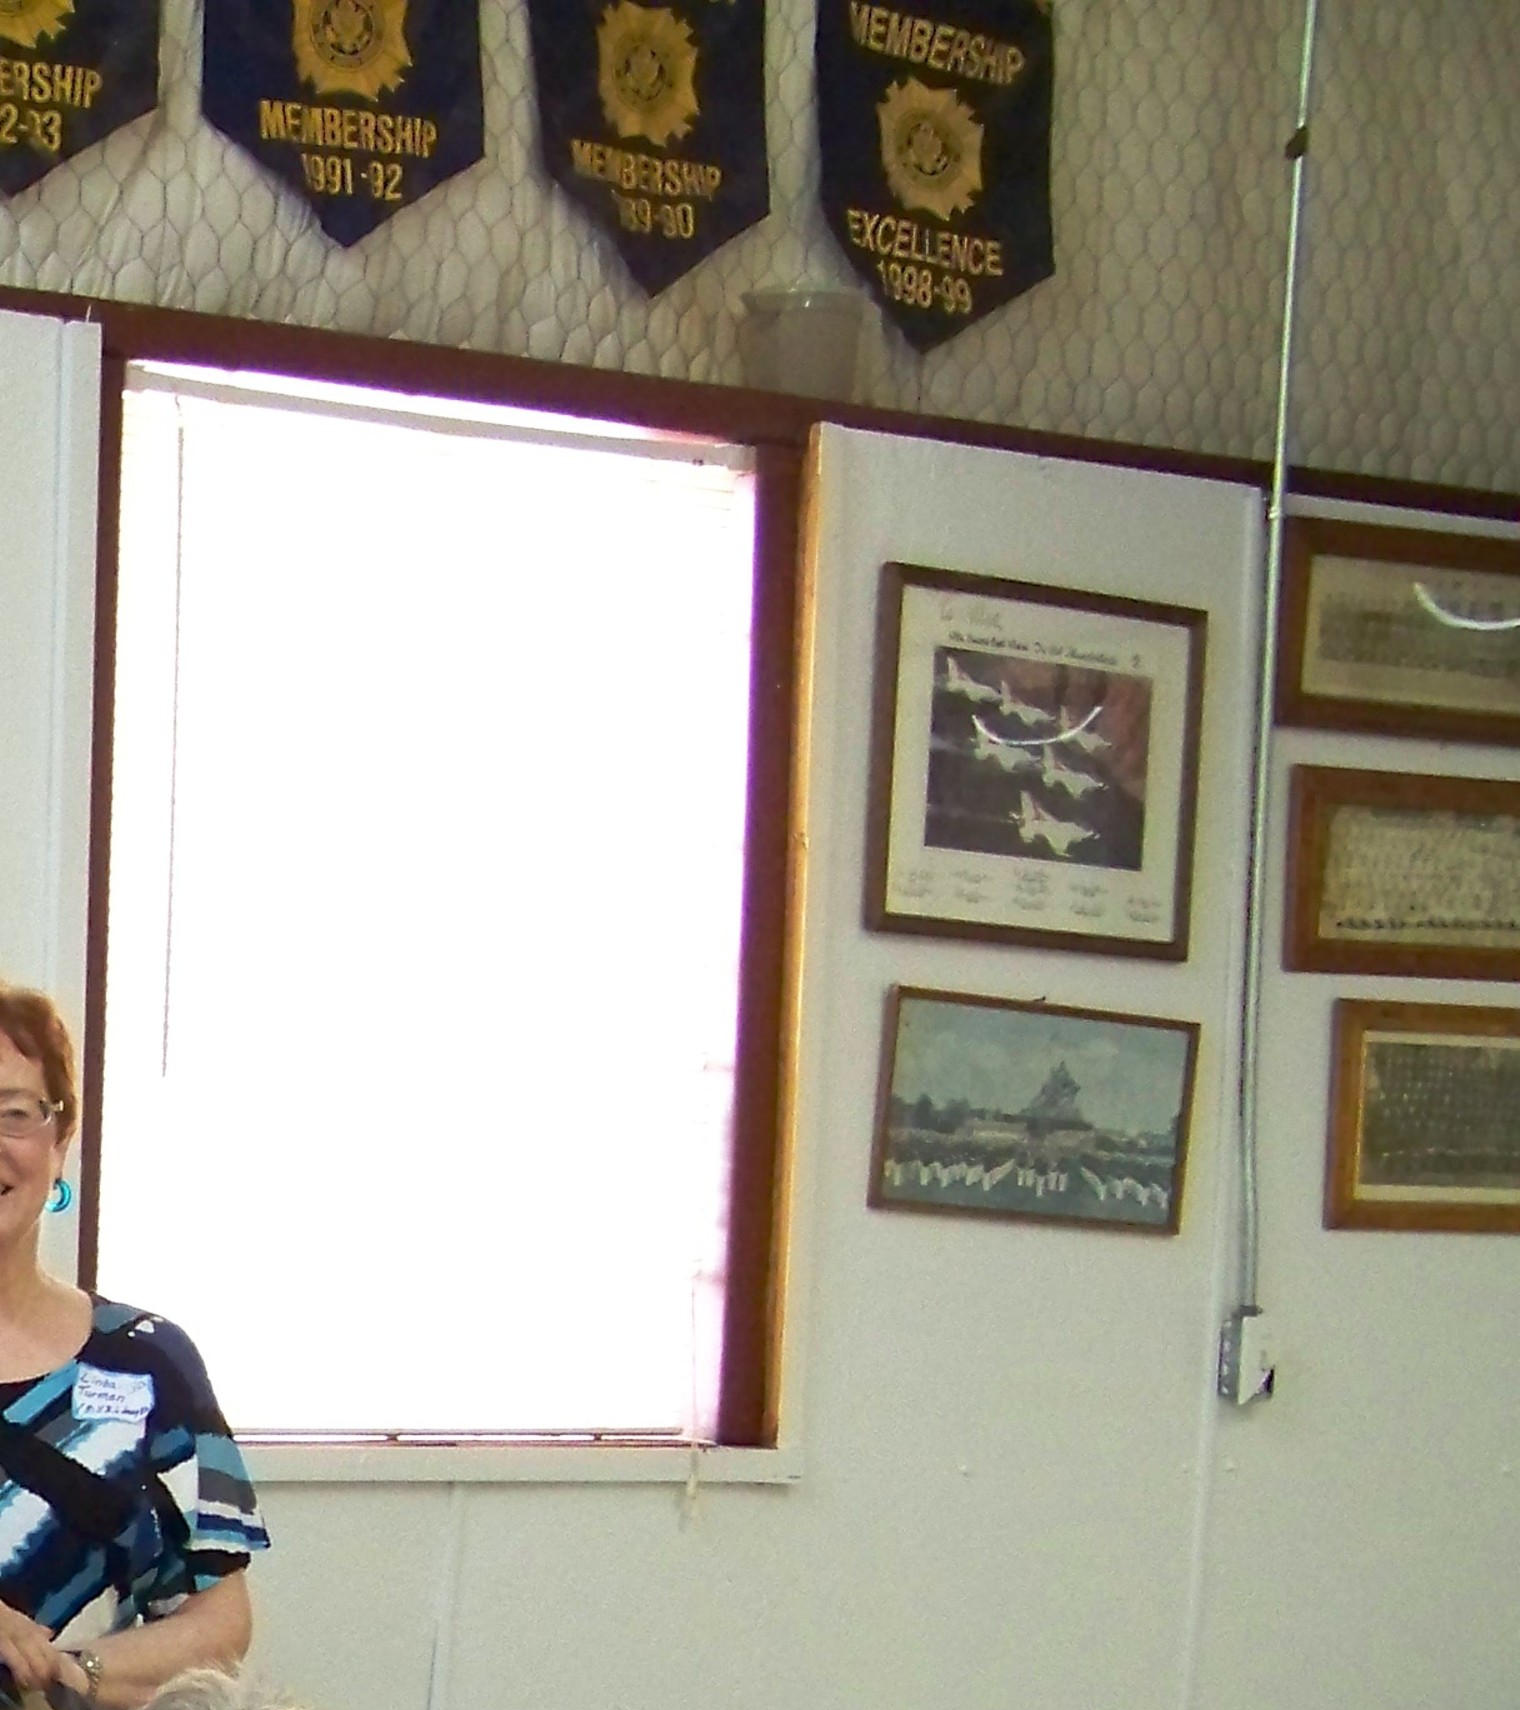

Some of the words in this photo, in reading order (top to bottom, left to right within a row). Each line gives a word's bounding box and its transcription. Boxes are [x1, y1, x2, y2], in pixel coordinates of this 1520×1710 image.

[850, 1, 1025, 85] MEMBERSHIP
[259, 99, 438, 158] MEMBERSHIP
[301, 153, 403, 201] 1991-92
[847, 208, 1004, 276] EXCELLENCE
[876, 258, 973, 314] 1998-99
